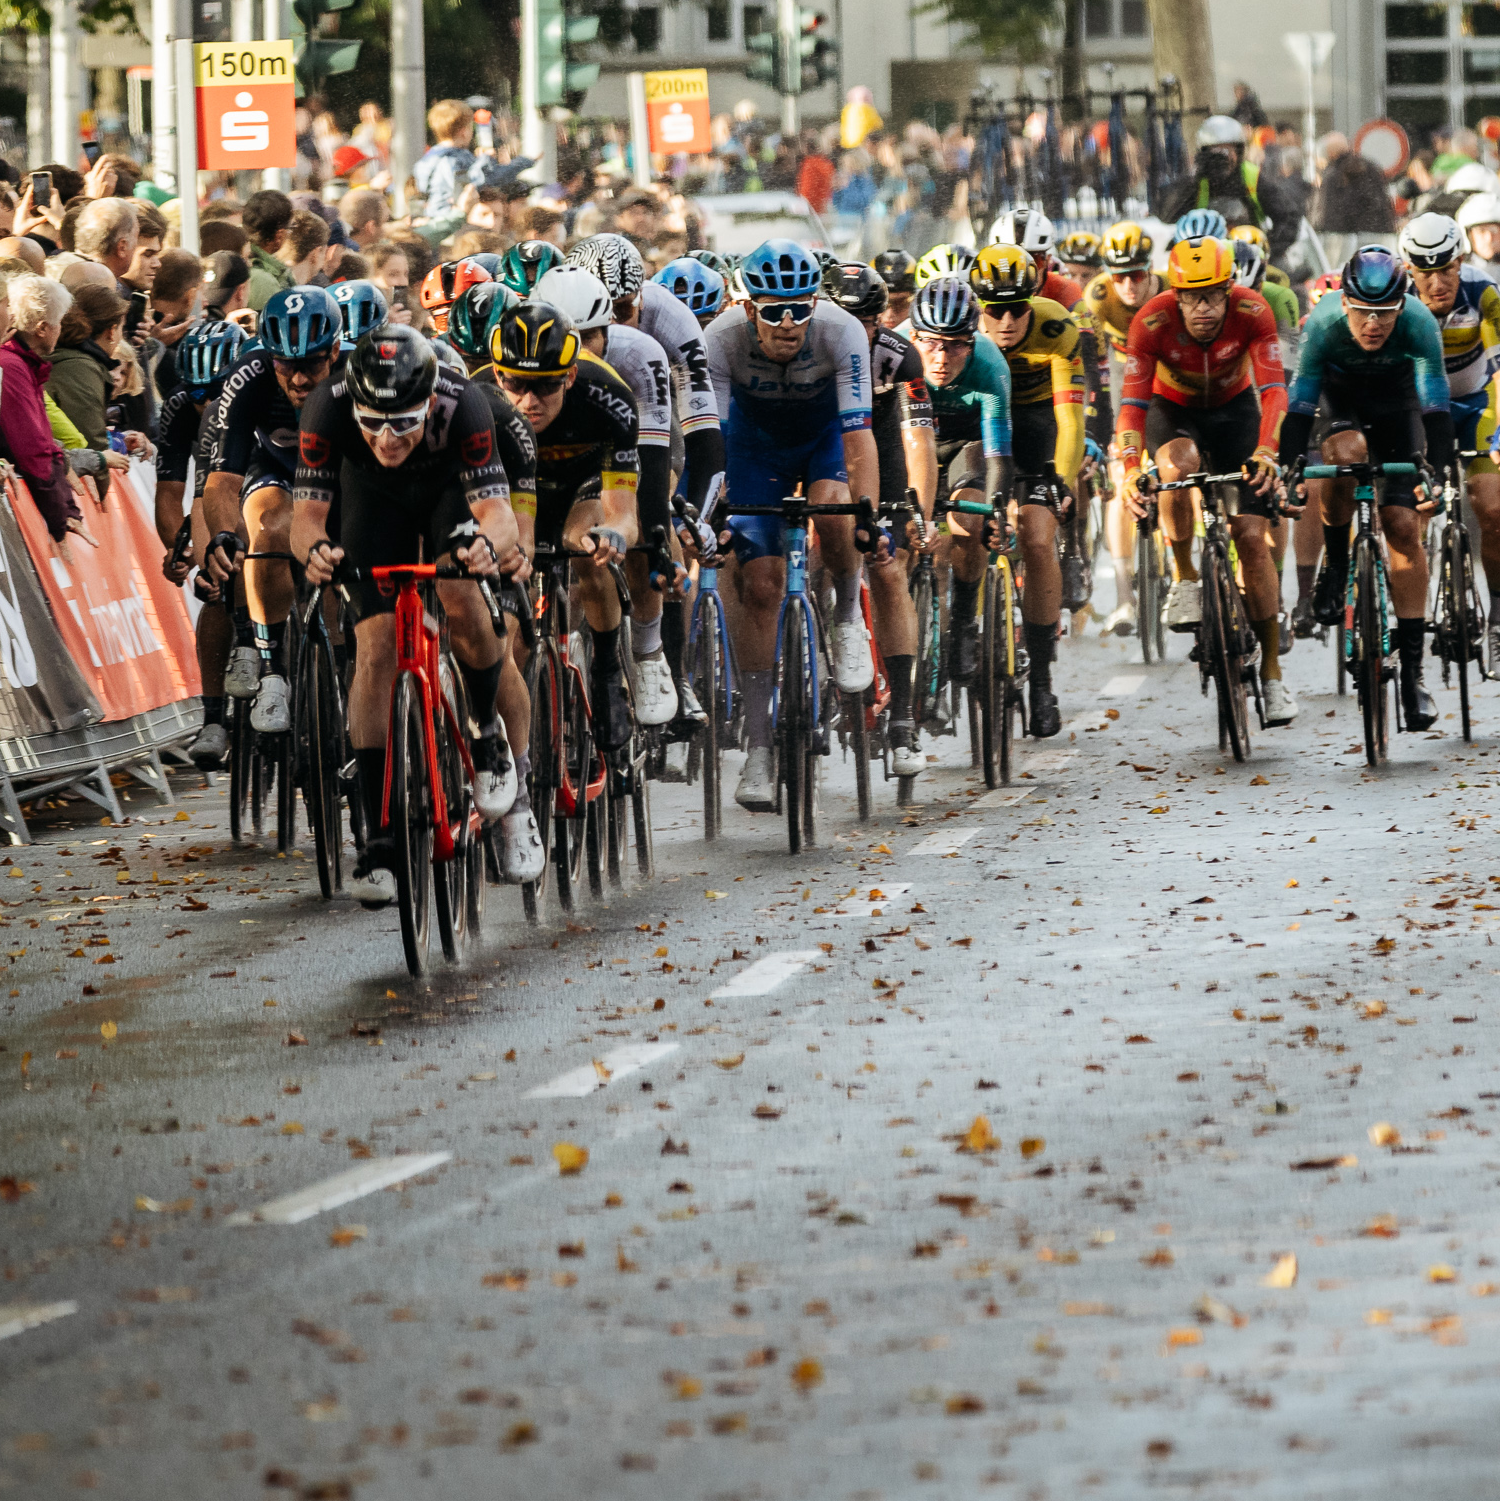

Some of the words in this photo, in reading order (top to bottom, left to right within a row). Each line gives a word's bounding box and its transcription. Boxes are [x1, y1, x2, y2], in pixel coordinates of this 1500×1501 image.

[200, 51, 287, 78] 150m
[645, 78, 705, 98] 200m
[879, 332, 908, 354] BMC
